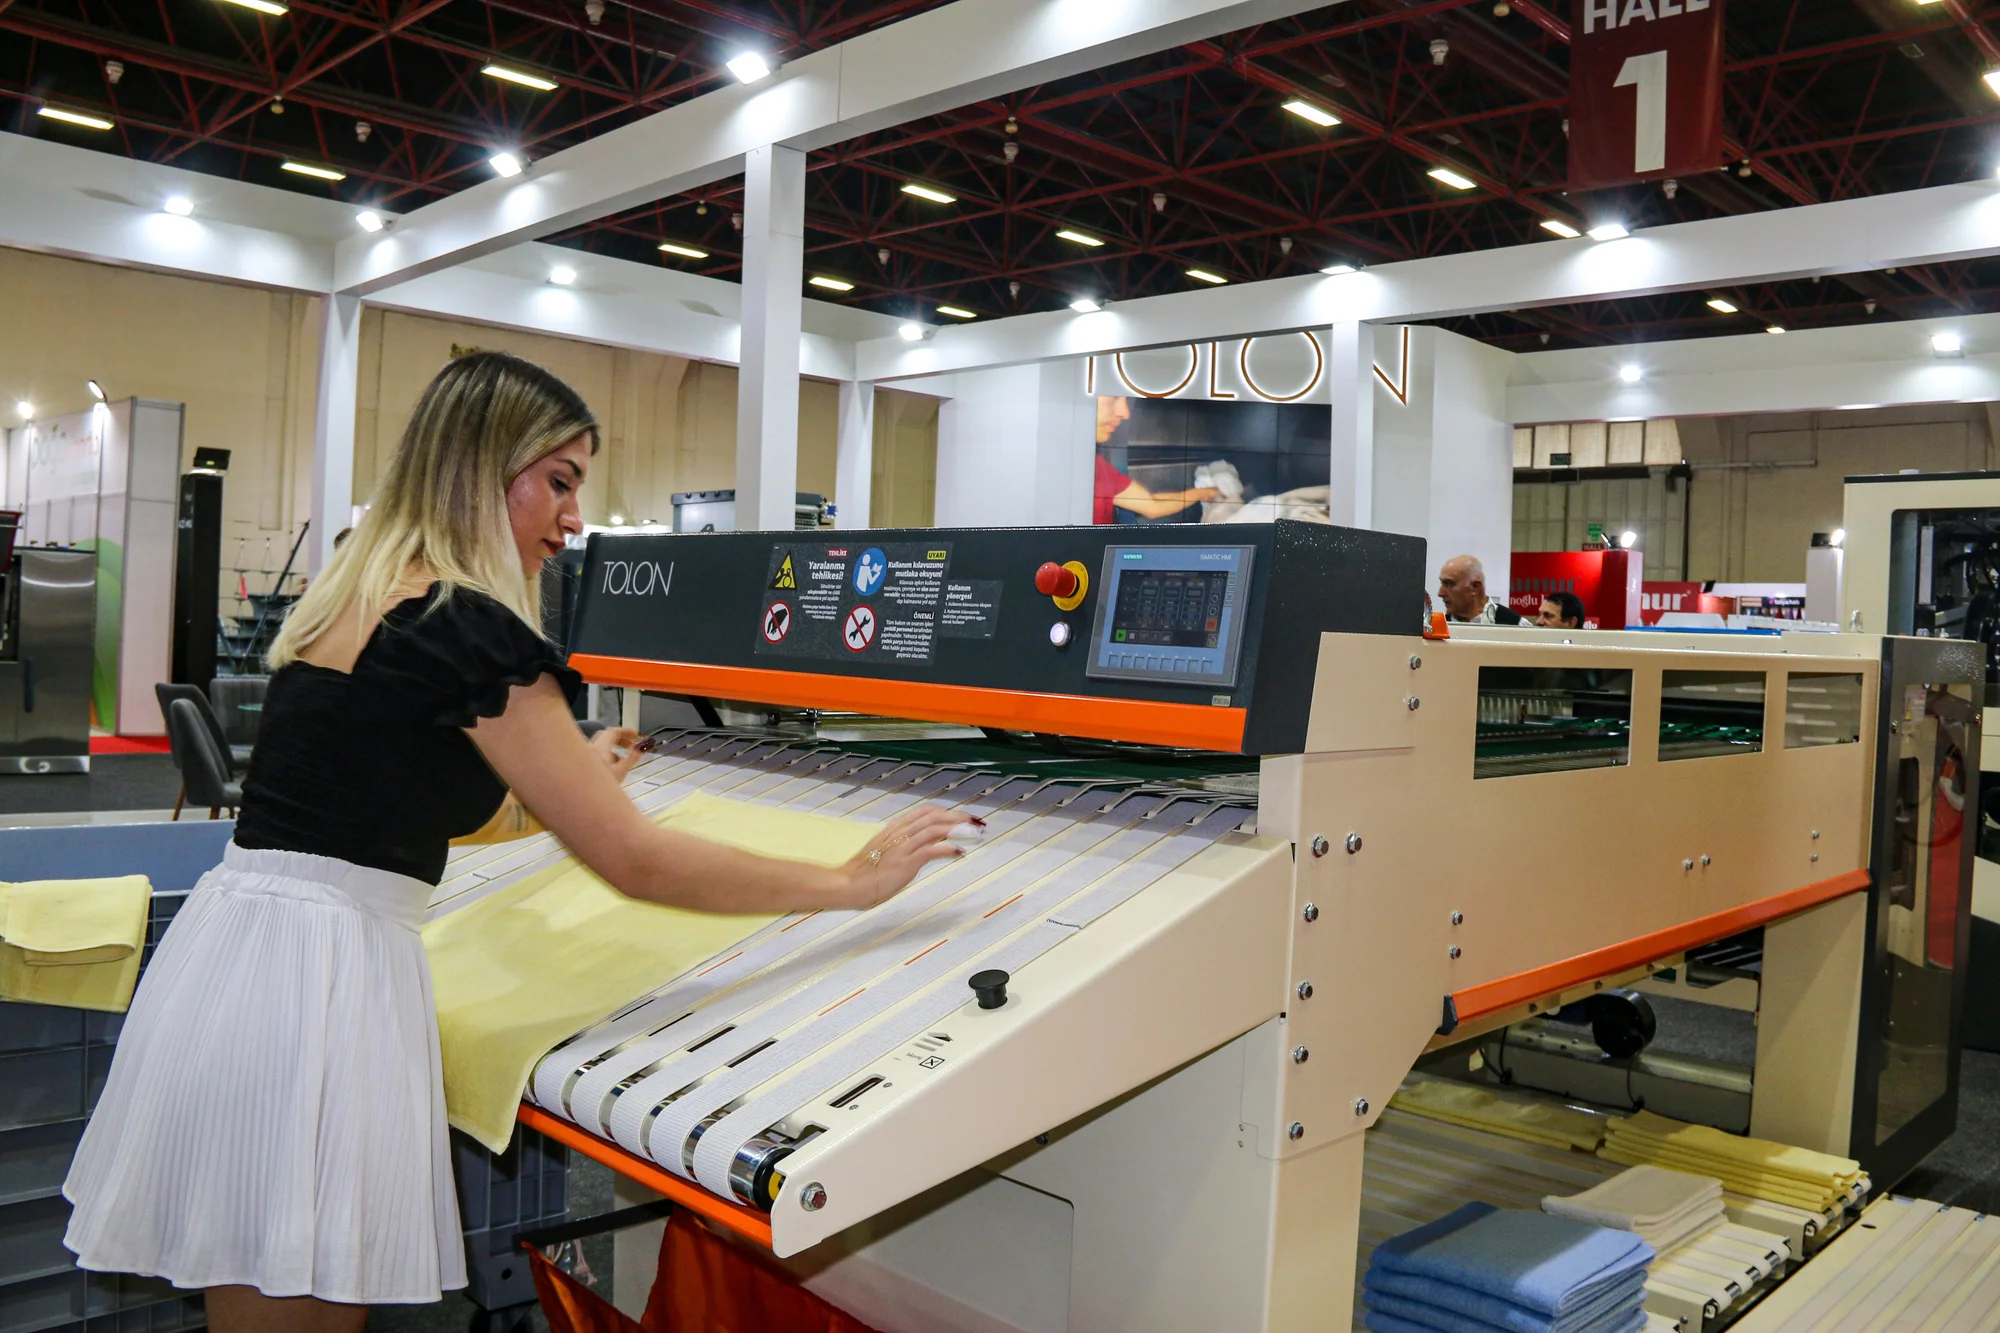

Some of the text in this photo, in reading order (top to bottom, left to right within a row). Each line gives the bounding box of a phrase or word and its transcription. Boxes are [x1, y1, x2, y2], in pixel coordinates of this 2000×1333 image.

[1613, 50, 1667, 173] 1
[809, 561, 845, 570] Yaralanma
[888, 561, 944, 569] Kullanım kılavuzunu
[602, 561, 674, 596] TOLON
[812, 570, 844, 580] tehlikesi!
[919, 570, 943, 579] okuyun!
[913, 611, 935, 619] ÖNEMLİ
